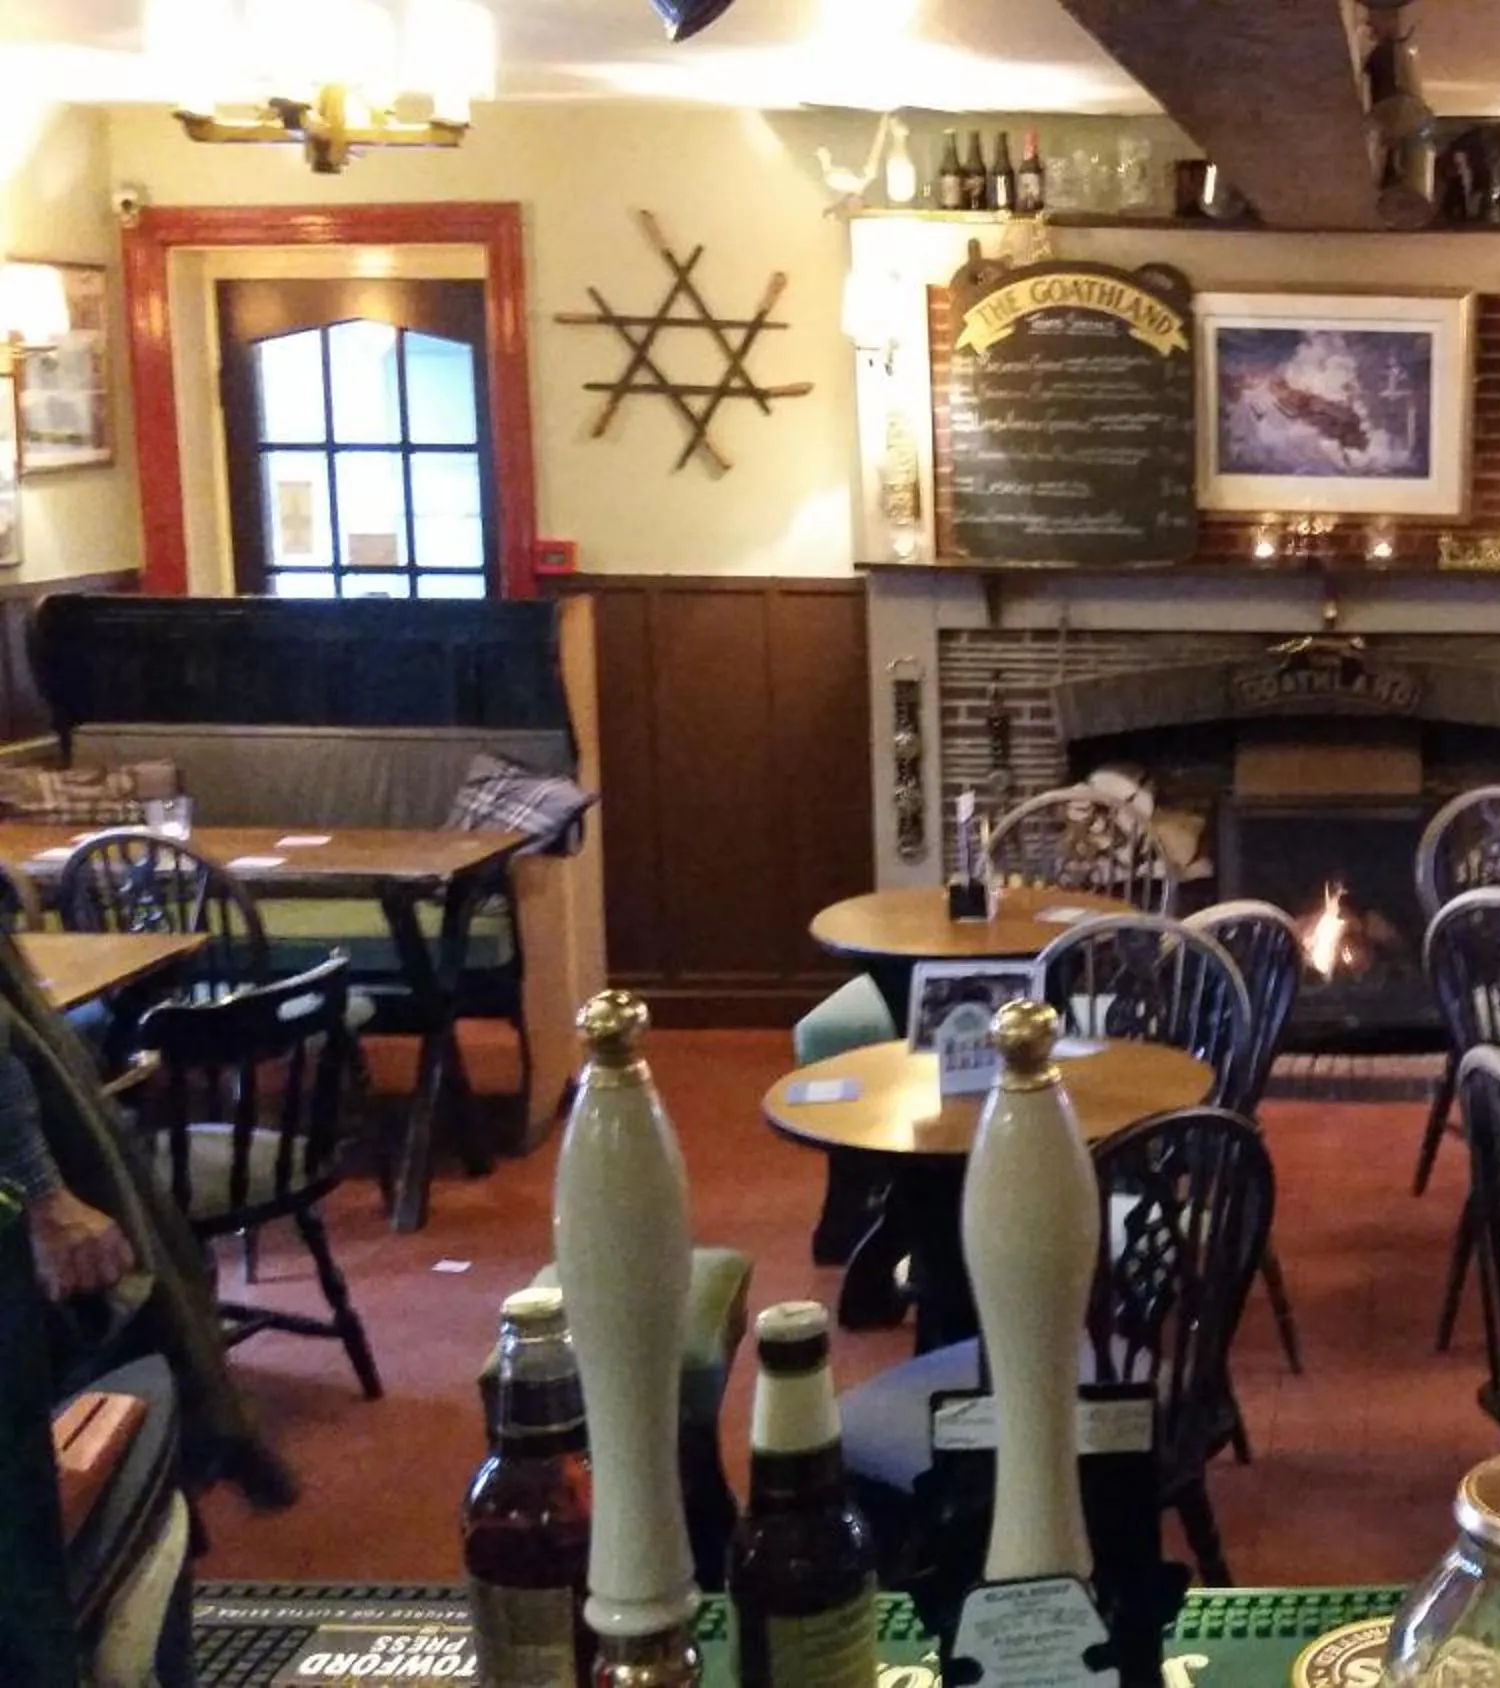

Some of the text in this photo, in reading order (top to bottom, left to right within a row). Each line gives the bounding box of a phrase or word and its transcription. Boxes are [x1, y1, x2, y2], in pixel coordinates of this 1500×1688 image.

[976, 288, 1020, 326] THE
[1030, 279, 1173, 335] GOATHLAND
[370, 1634, 468, 1655] PRESS
